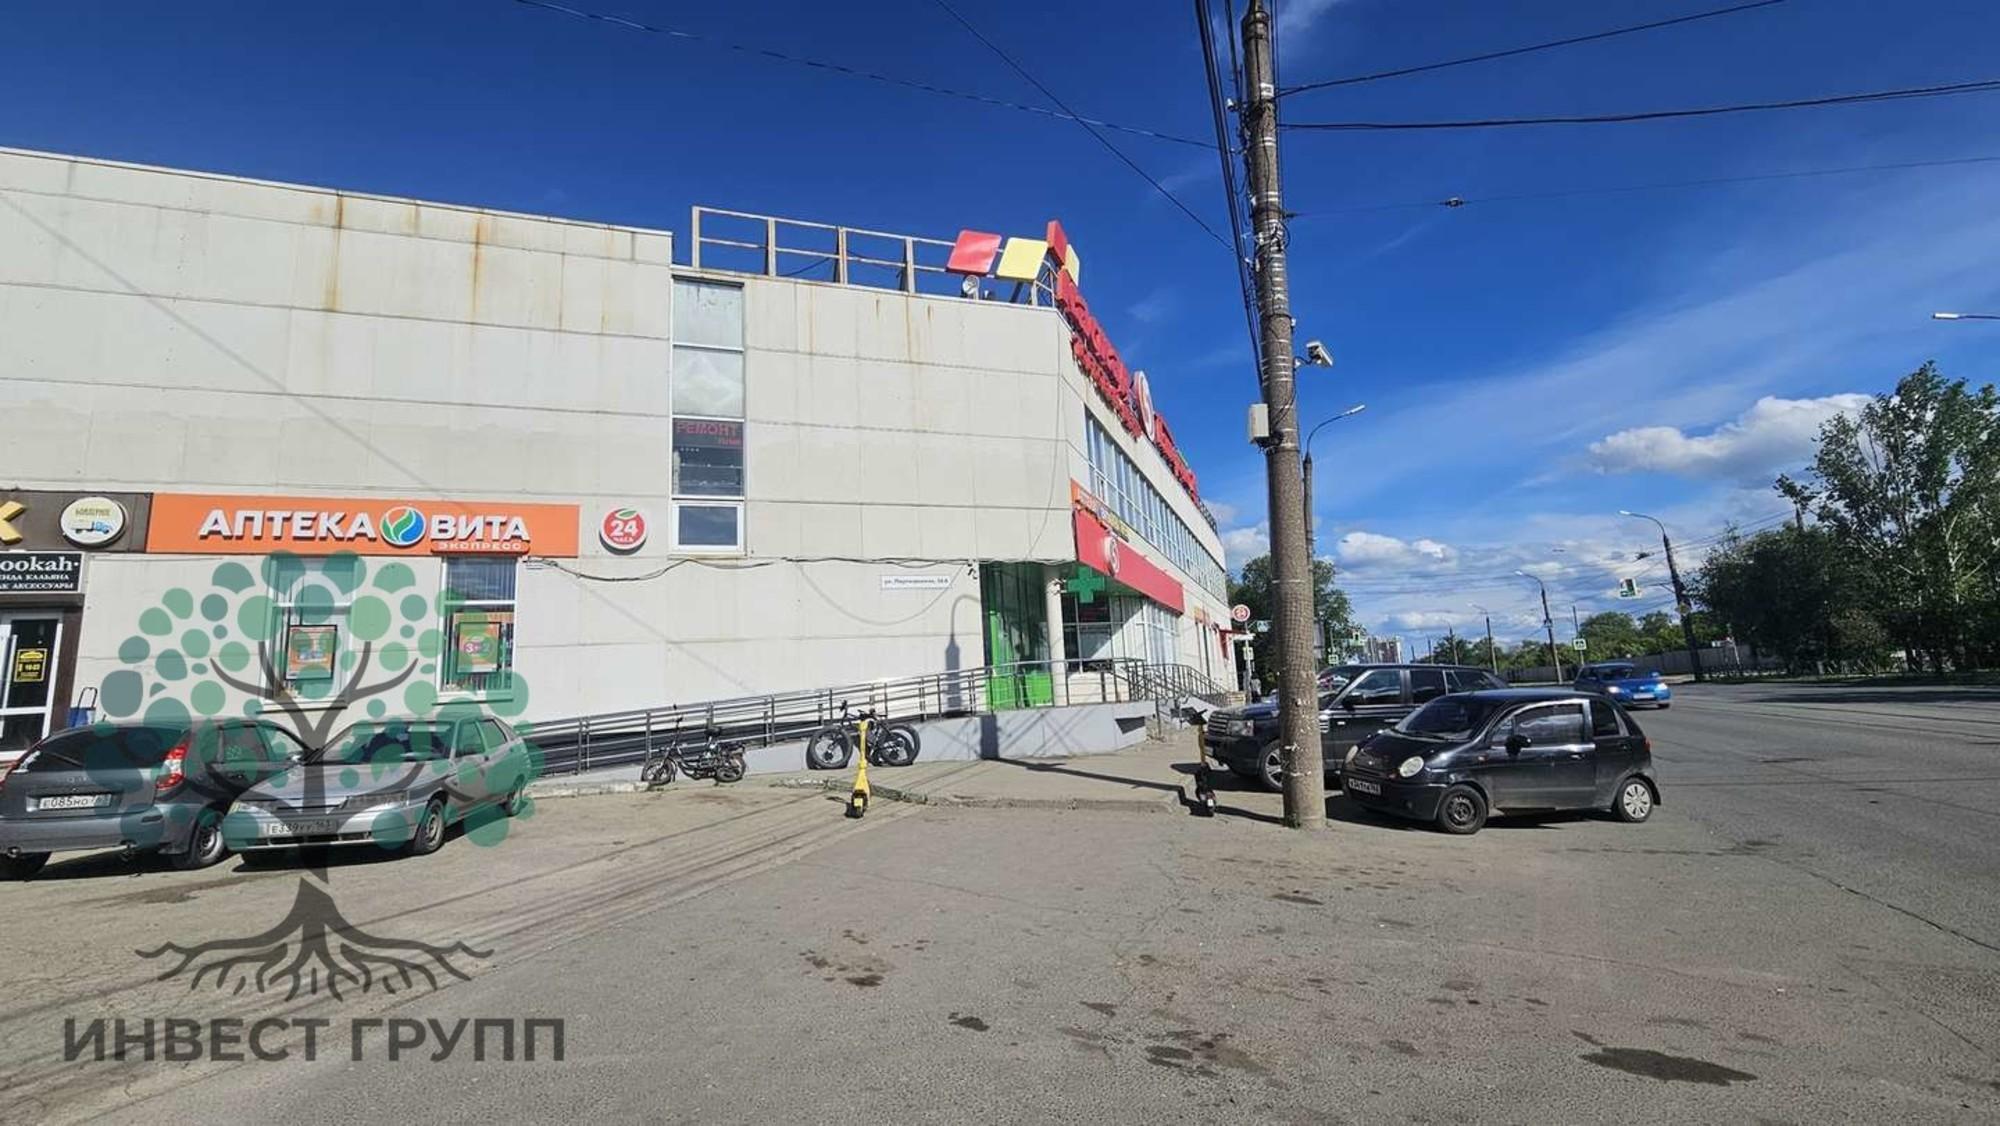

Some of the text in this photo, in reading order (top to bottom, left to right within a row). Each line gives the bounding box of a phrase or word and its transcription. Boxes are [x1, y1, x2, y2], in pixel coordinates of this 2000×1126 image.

[198, 509, 530, 542] АПТЕКА ВИТА
[609, 520, 639, 537] 24
[439, 541, 522, 551] ЭКСПРЕСС
